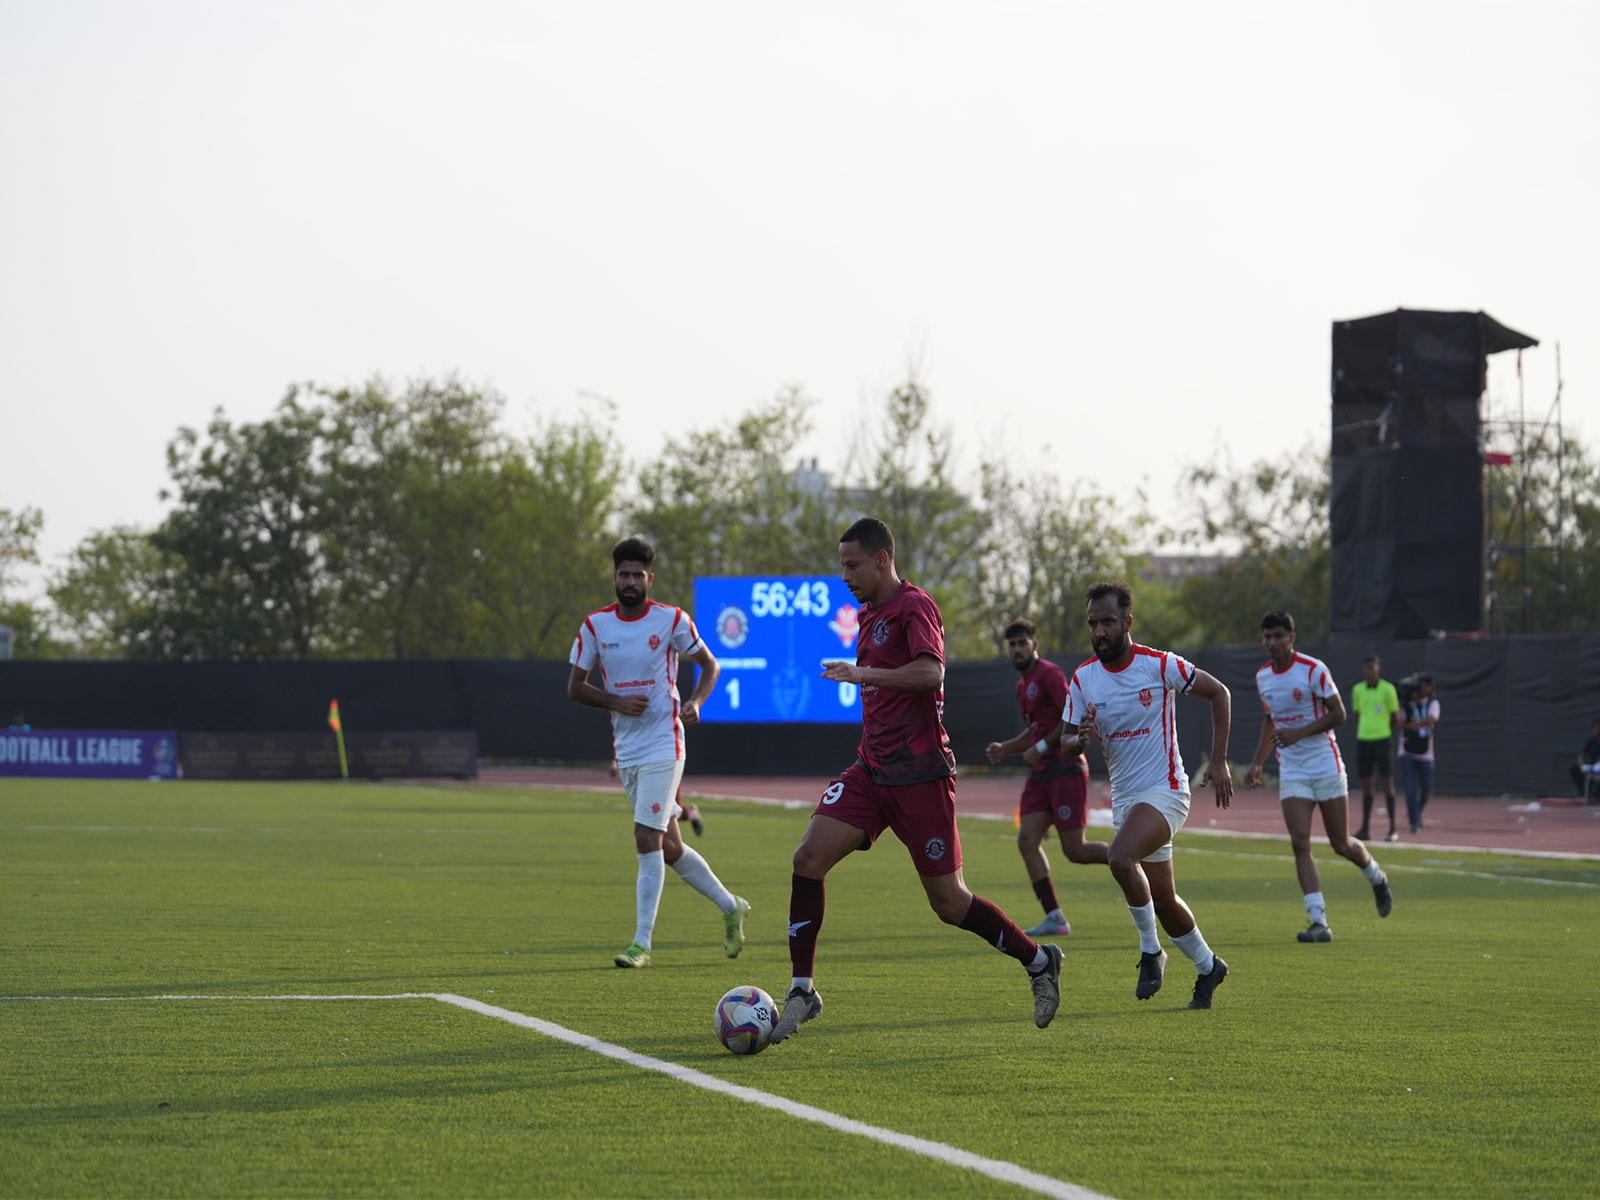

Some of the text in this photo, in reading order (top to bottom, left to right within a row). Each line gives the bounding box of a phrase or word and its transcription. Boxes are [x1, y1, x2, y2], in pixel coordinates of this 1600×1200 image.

[751, 581, 831, 617] 56:43
[725, 678, 740, 709] 1
[838, 682, 857, 708] 0
[76, 737, 142, 765] LEAGUE
[822, 782, 845, 805] 9
